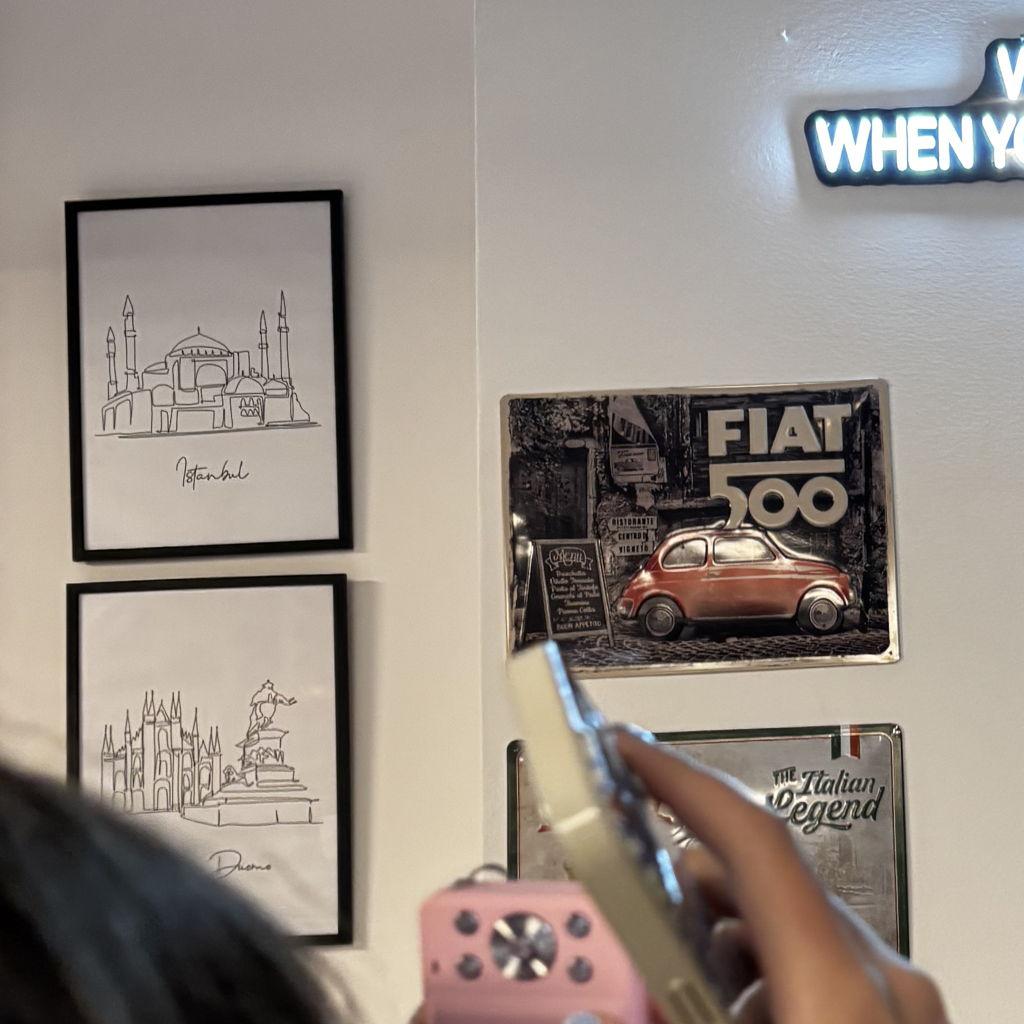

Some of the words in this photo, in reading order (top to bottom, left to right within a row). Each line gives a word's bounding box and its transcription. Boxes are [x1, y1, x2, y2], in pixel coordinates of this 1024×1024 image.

[814, 114, 976, 174] WHEN
[708, 403, 852, 457] FIAT
[176, 456, 249, 490] Istanbul
[709, 458, 849, 529] 500
[773, 766, 796, 785] THE
[796, 769, 876, 796] Italian
[766, 786, 885, 835] Legend
[209, 850, 272, 879] Duomo
